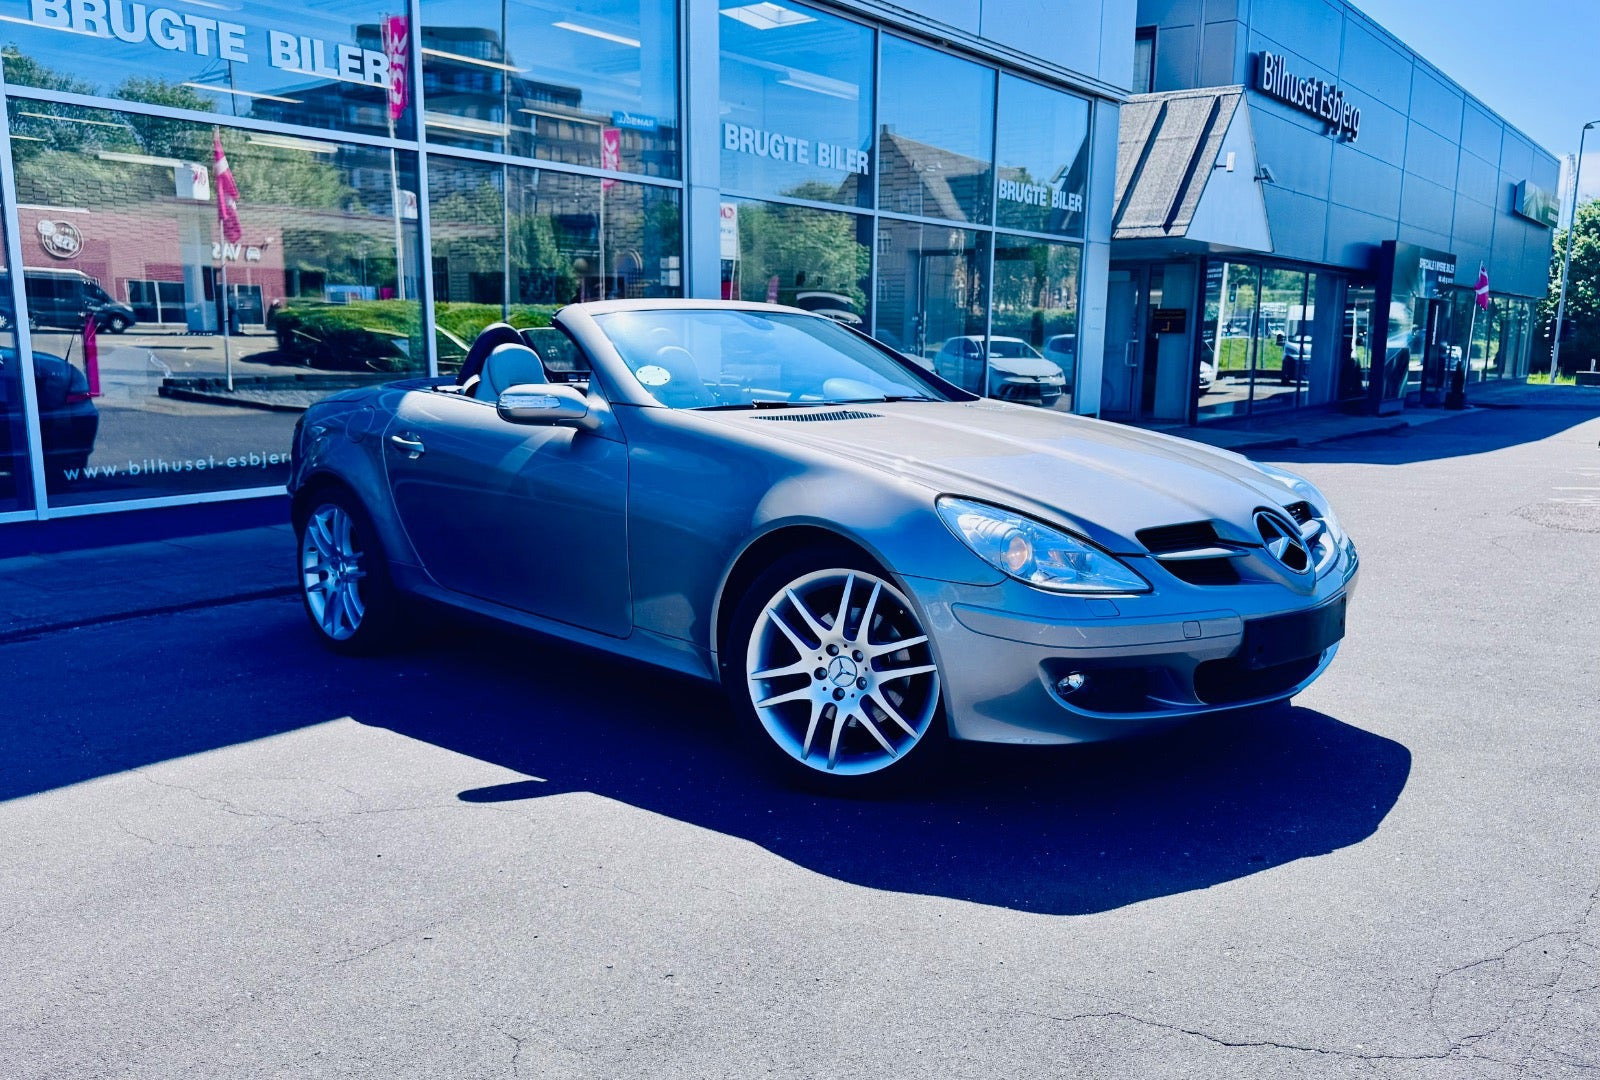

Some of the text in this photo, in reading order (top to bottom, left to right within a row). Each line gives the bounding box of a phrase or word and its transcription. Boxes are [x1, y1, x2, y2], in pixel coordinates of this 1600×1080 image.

[31, 0, 390, 87] BRUGTE BILER
[1263, 50, 1361, 142] Bilhuset Esbjerg
[724, 122, 869, 175] BRUGTE BILER
[998, 179, 1083, 213] BRUGTE BILER
[64, 451, 291, 481] www.bilhuset-esbjer
